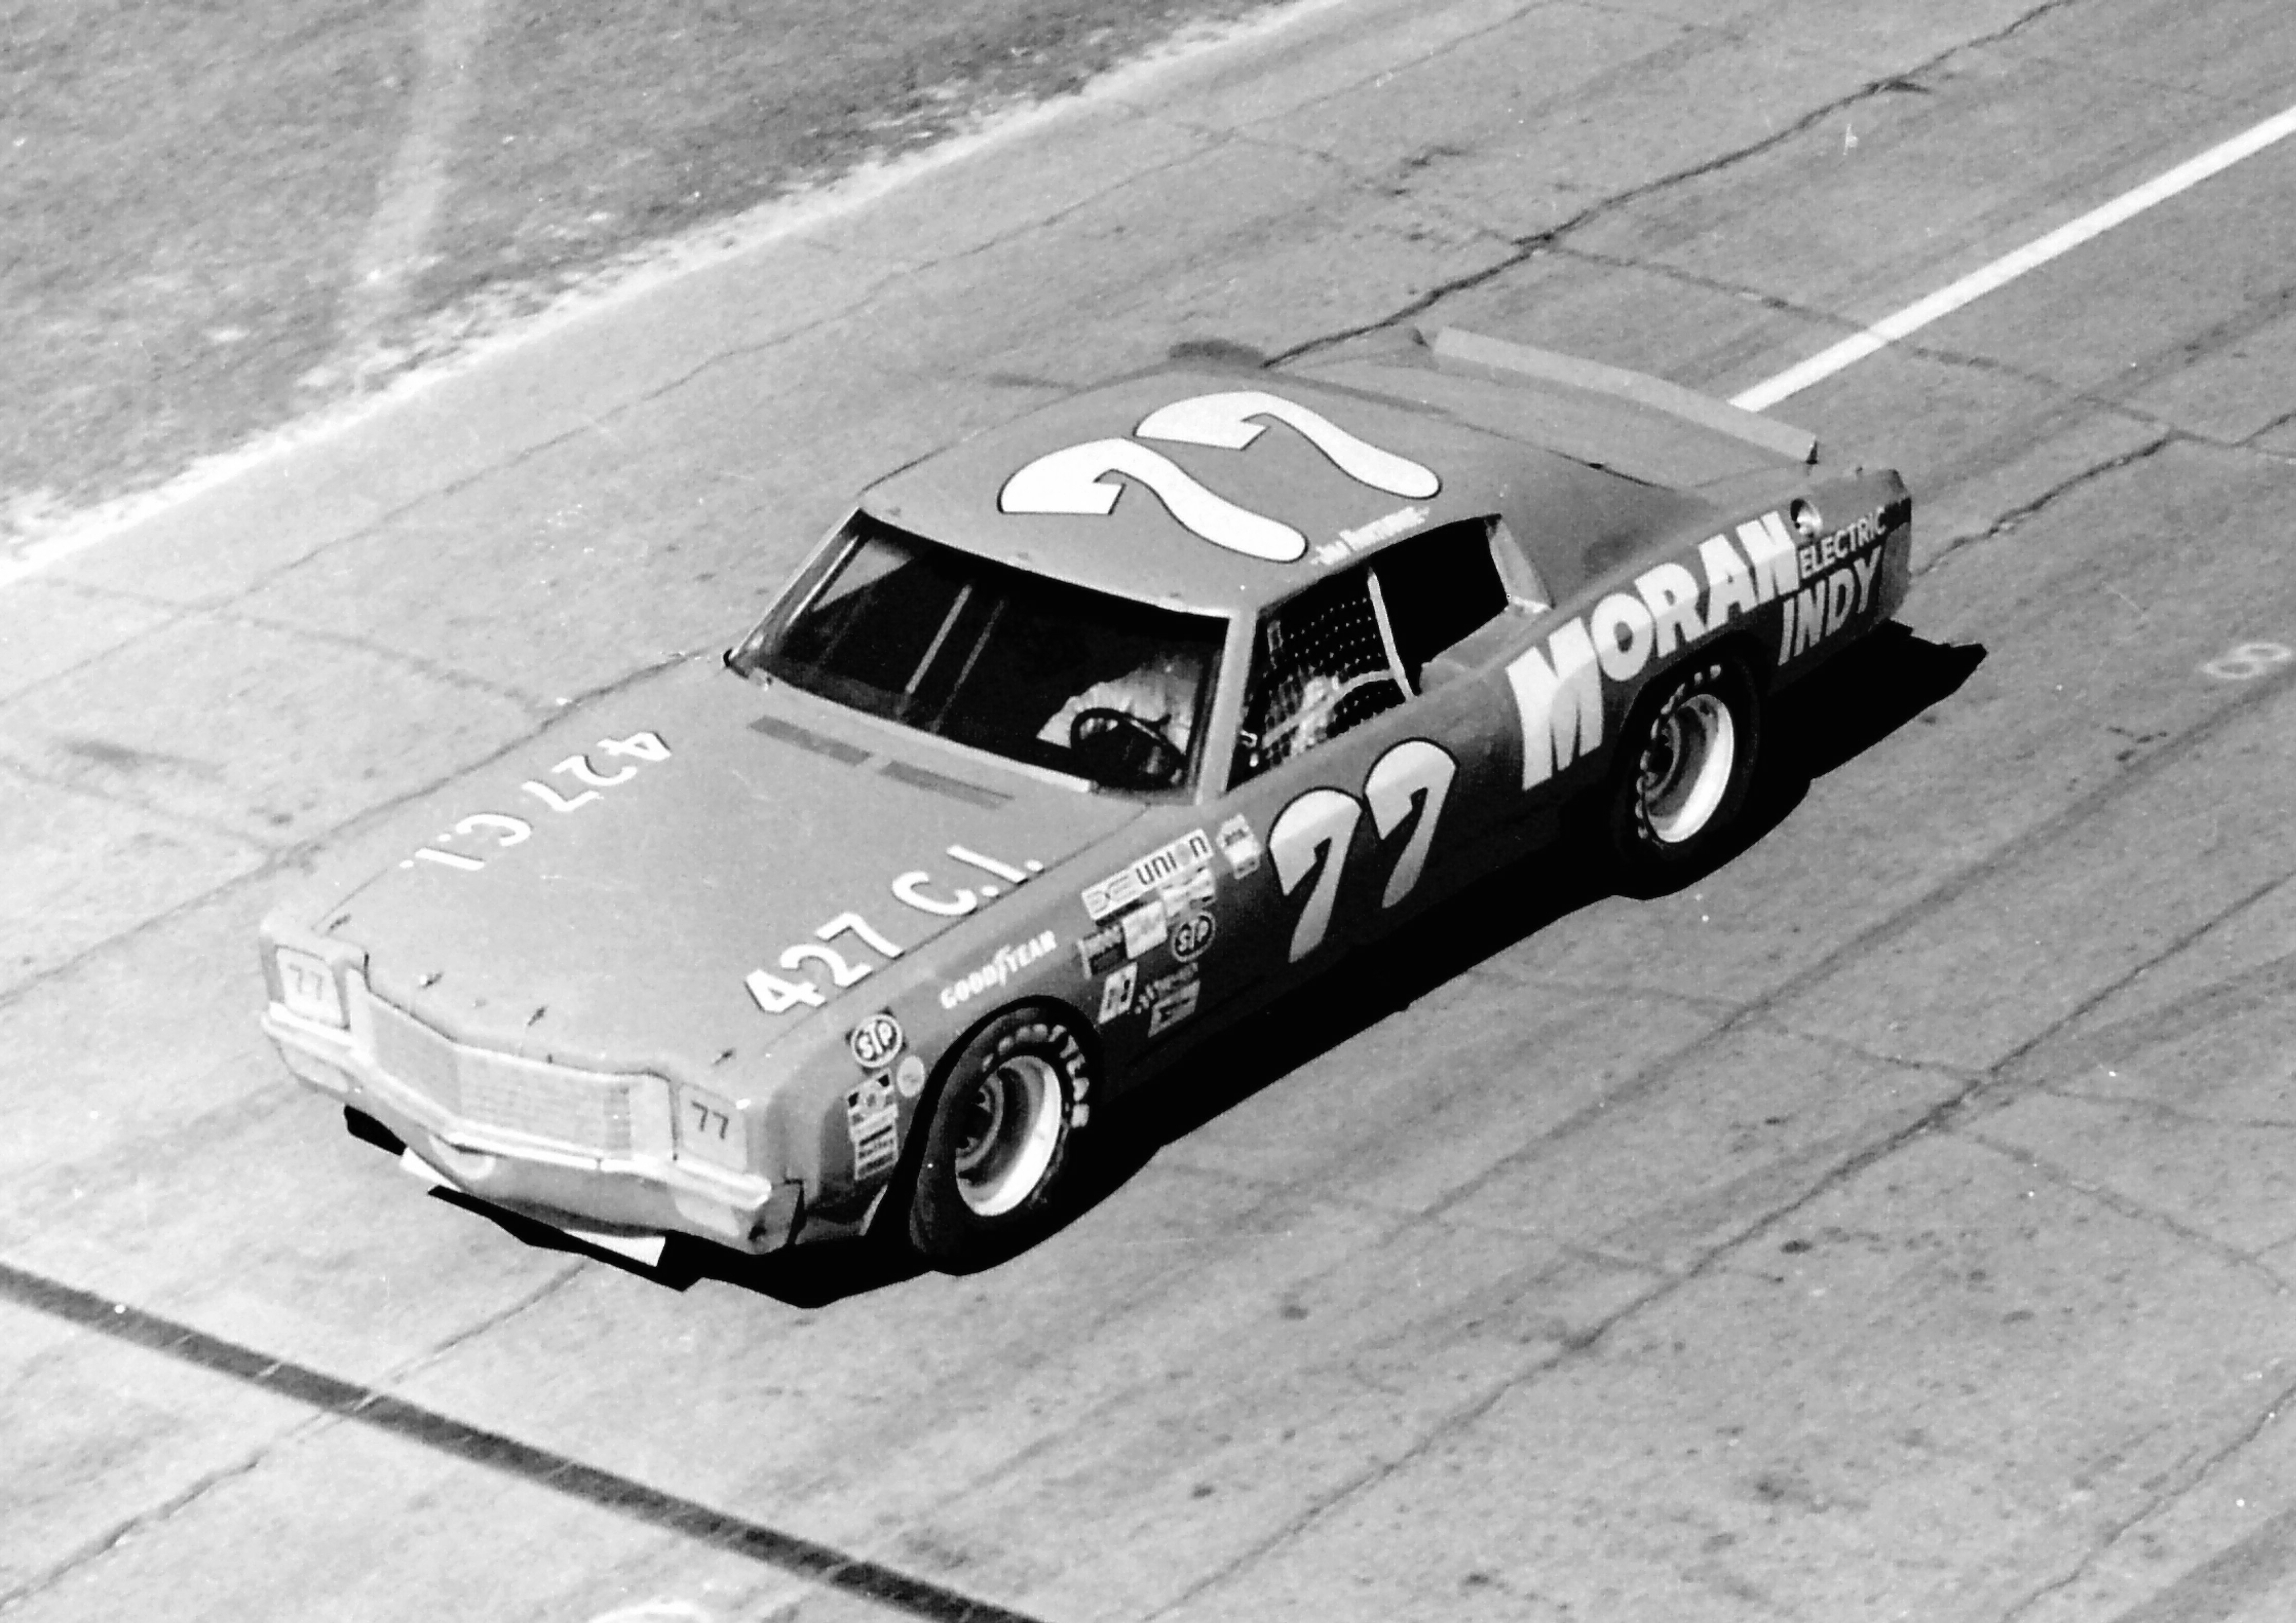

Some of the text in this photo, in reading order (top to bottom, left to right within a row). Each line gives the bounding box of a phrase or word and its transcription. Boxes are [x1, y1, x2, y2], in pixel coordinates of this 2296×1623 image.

[997, 391, 1442, 563] 77
[1798, 505, 1887, 579] ELECTRIC
[1777, 544, 1883, 666] INDY
[1505, 511, 1800, 791] MORAN
[521, 730, 672, 812] 427
[1267, 737, 1459, 963] 77
[288, 962, 324, 1001] 77
[743, 911, 905, 1013] 427
[939, 929, 1056, 1009] GOODYEAR
[856, 1017, 895, 1061] STP
[691, 1101, 729, 1141] 77
